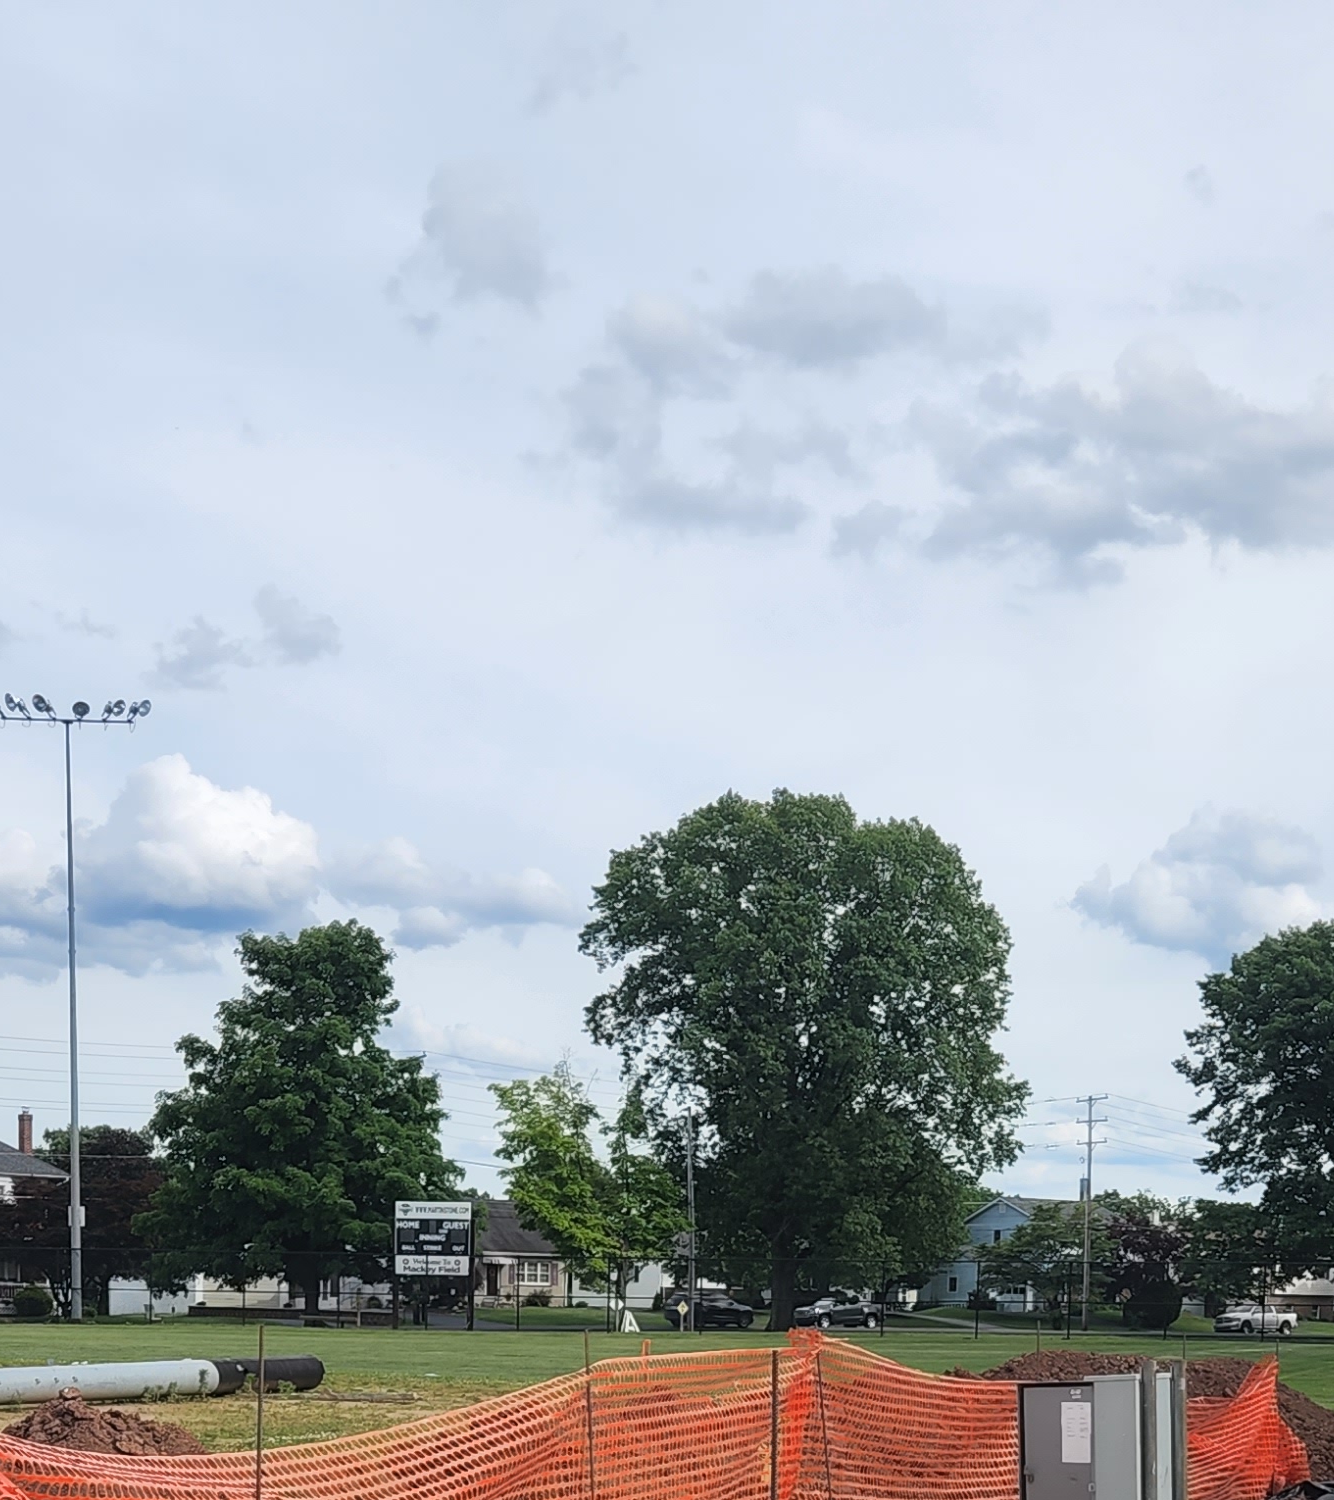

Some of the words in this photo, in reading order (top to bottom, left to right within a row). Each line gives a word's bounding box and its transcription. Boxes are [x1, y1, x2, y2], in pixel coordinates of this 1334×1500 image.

[396, 1221, 419, 1229] HOME
[442, 1222, 469, 1230] GUEST
[419, 1233, 446, 1241] INNING
